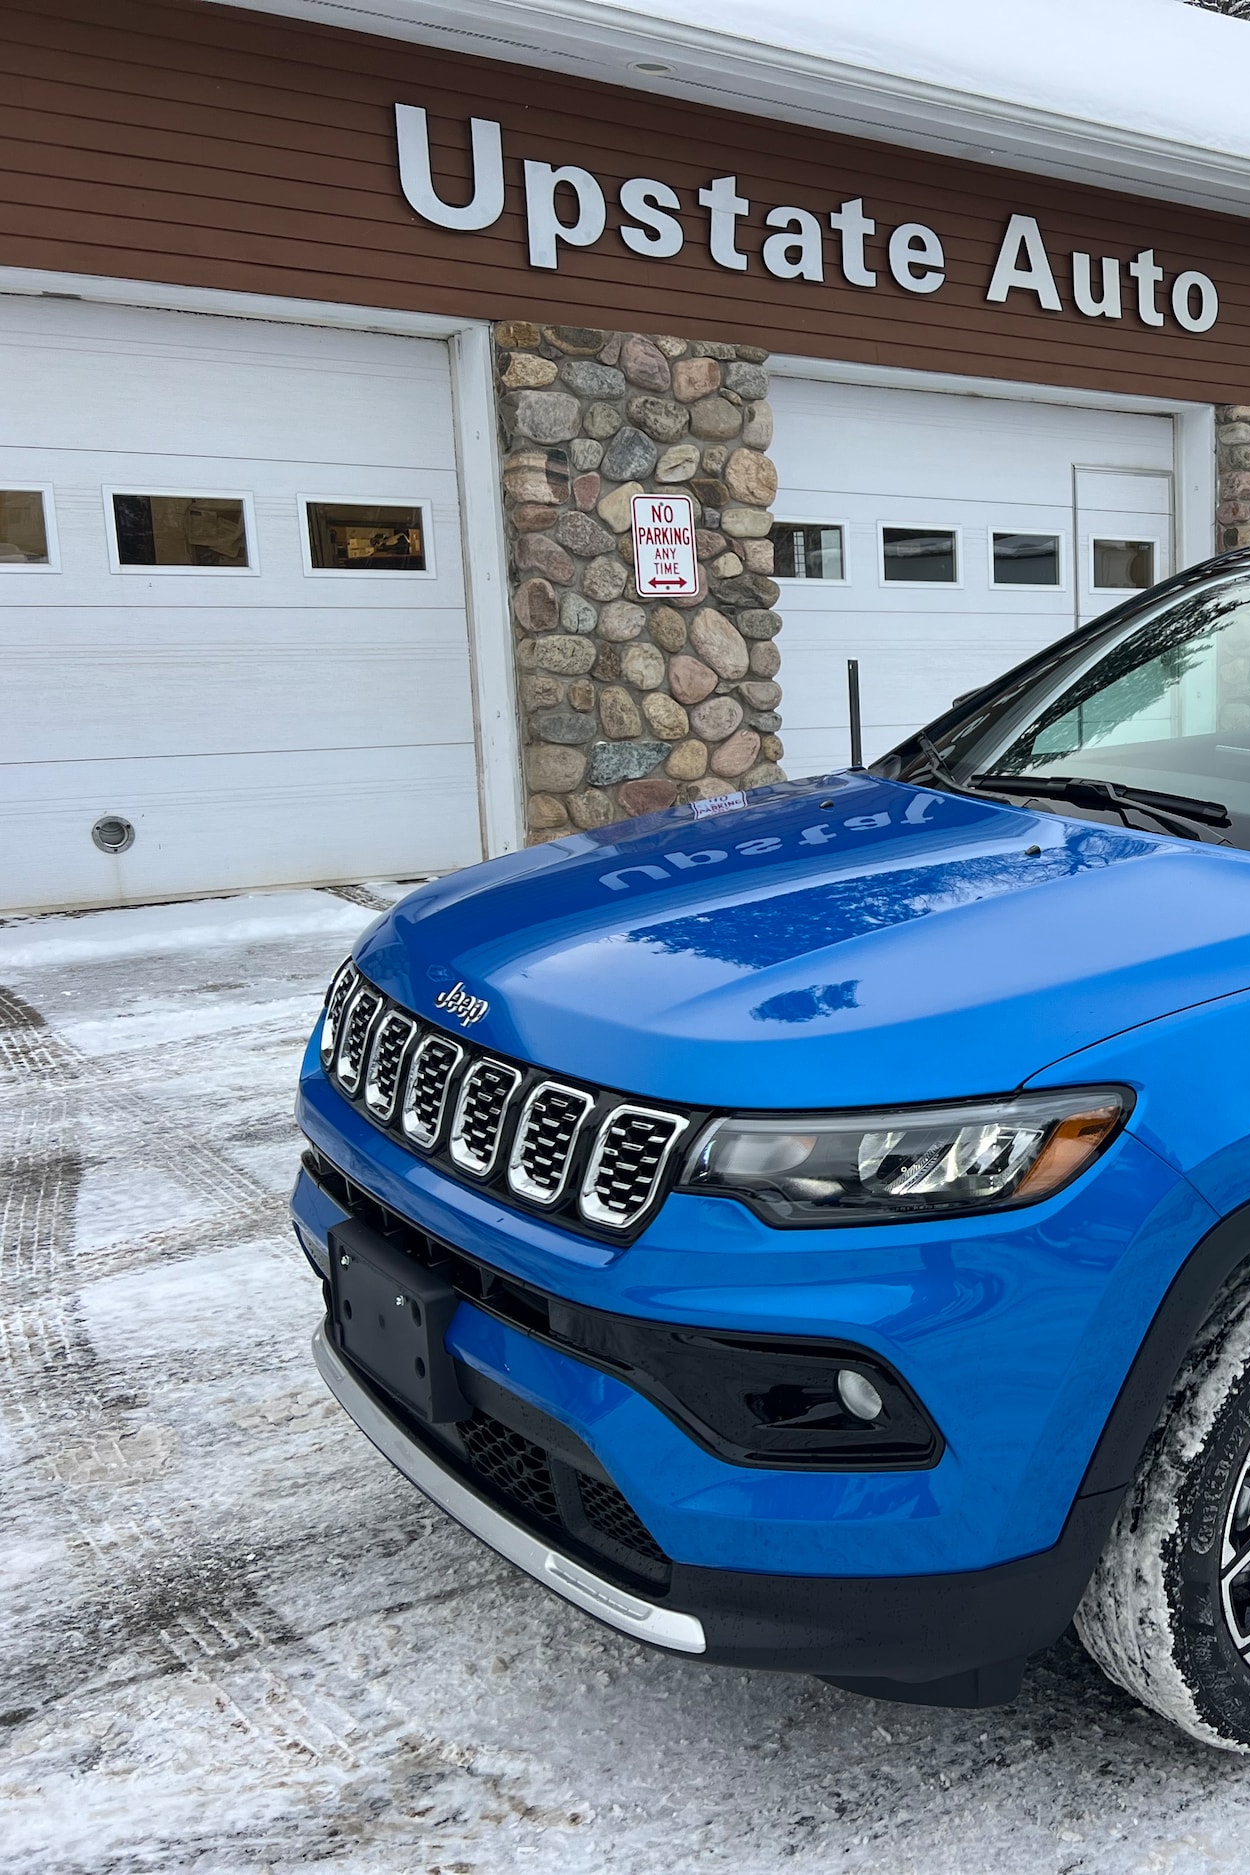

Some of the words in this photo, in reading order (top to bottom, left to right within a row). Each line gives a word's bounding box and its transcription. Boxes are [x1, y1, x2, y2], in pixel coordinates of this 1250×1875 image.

[393, 101, 946, 295] Upstate
[985, 212, 1221, 334] Auto
[651, 505, 673, 523] NO
[638, 527, 689, 545] PARKING
[655, 548, 676, 559] ANY
[653, 562, 679, 574] TIME
[435, 981, 489, 1027] Jeep
